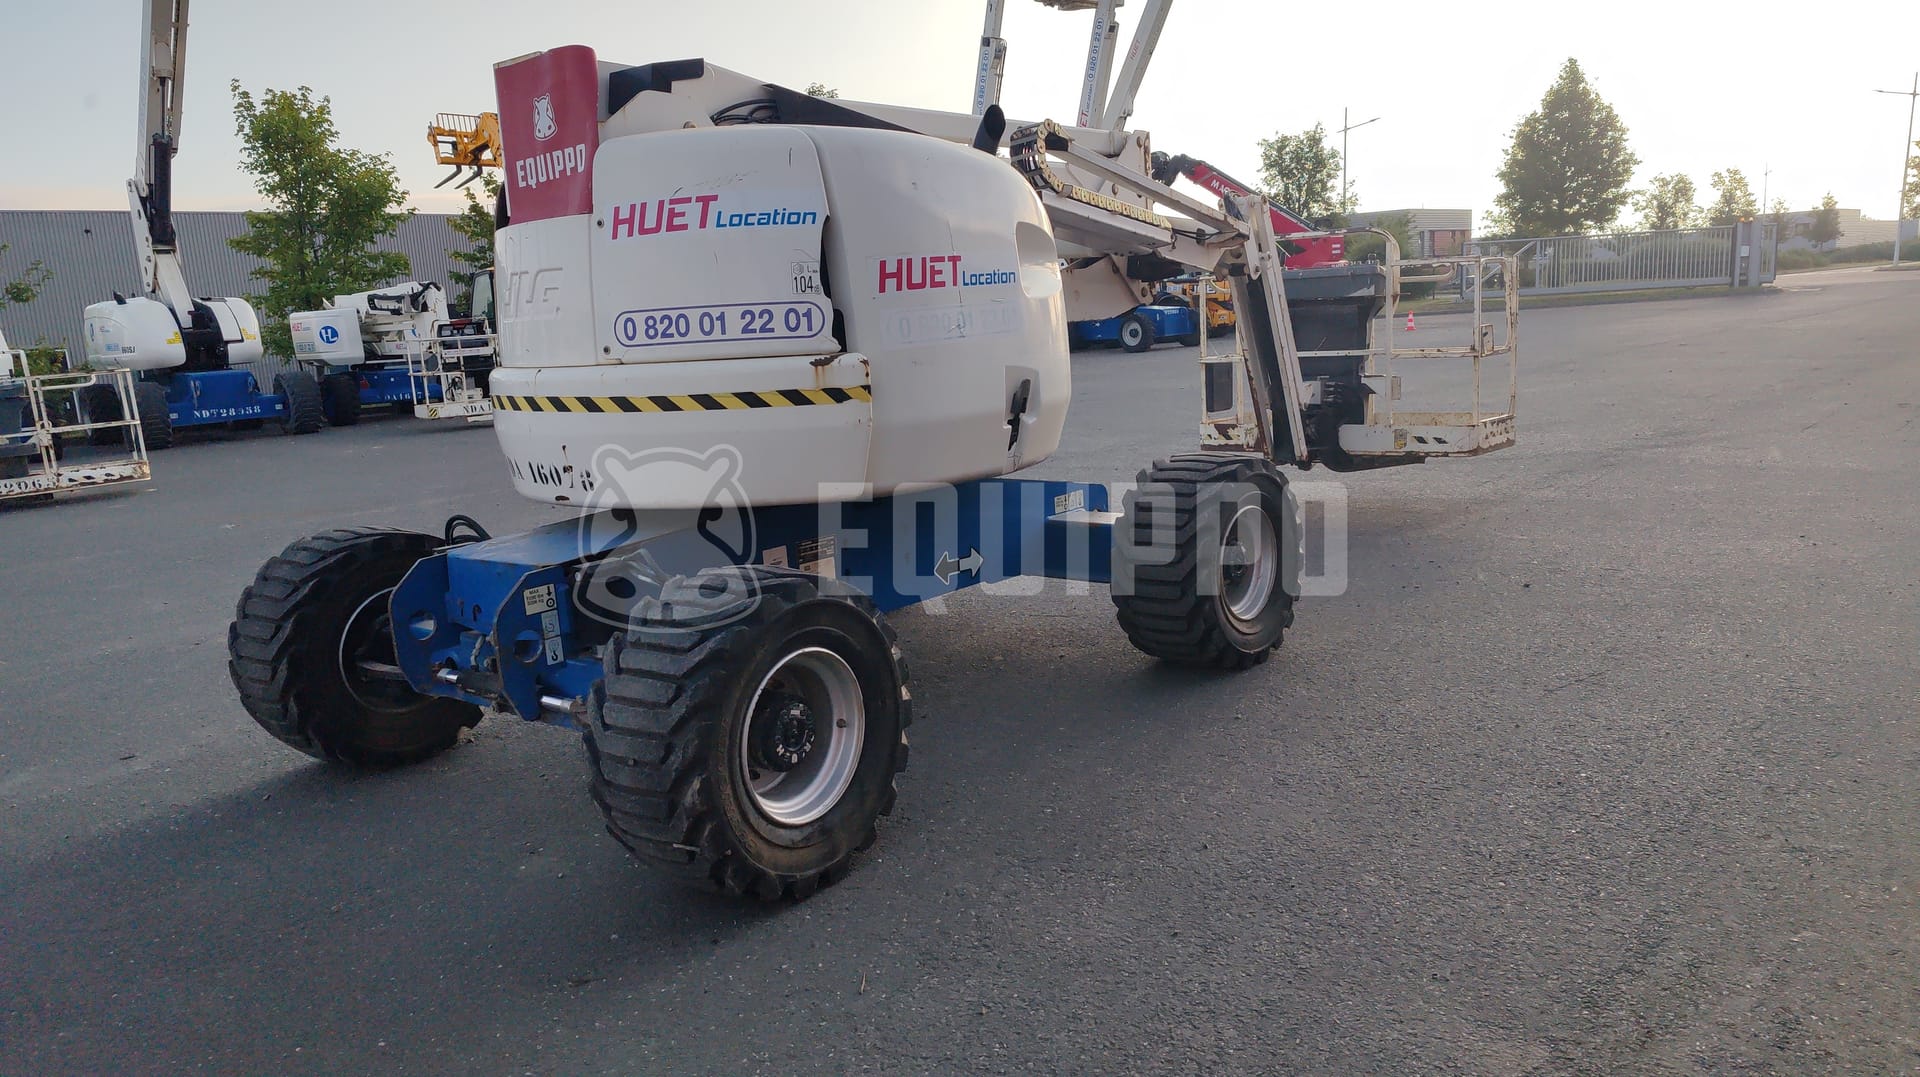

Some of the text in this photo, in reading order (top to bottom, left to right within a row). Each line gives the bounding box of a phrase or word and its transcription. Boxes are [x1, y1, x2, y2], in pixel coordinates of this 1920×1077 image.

[1079, 110, 1088, 127] ET
[611, 194, 817, 240] HUET Location
[793, 275, 813, 292] 104
[878, 255, 1016, 293] HUET Location
[623, 307, 813, 341] 0 820 01 22 01
